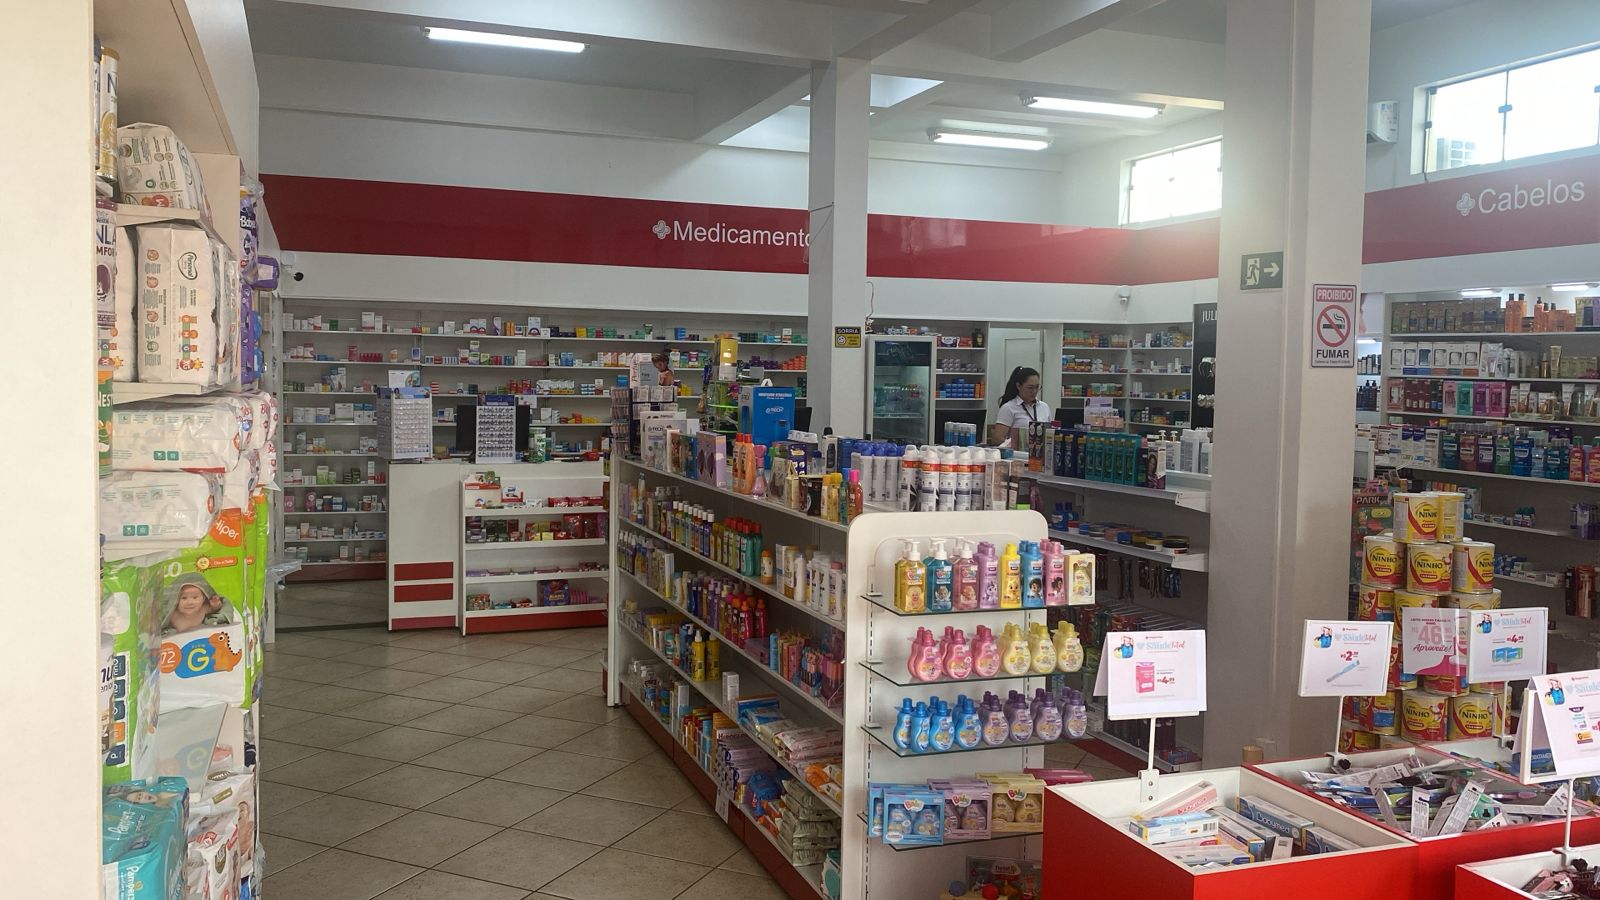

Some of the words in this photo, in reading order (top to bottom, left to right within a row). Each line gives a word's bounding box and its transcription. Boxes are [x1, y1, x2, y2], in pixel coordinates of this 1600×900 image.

[1478, 179, 1585, 214] Cabelos
[1317, 289, 1352, 300] PROIBIDO
[1316, 349, 1350, 359] FUMAR
[1356, 496, 1380, 504] PARK
[1371, 554, 1397, 563] NINHO
[1417, 561, 1443, 569] NINHO
[1418, 625, 1442, 645] 46
[187, 647, 210, 671] G
[1406, 707, 1430, 718] NINHO
[1462, 711, 1488, 719] NINHO
